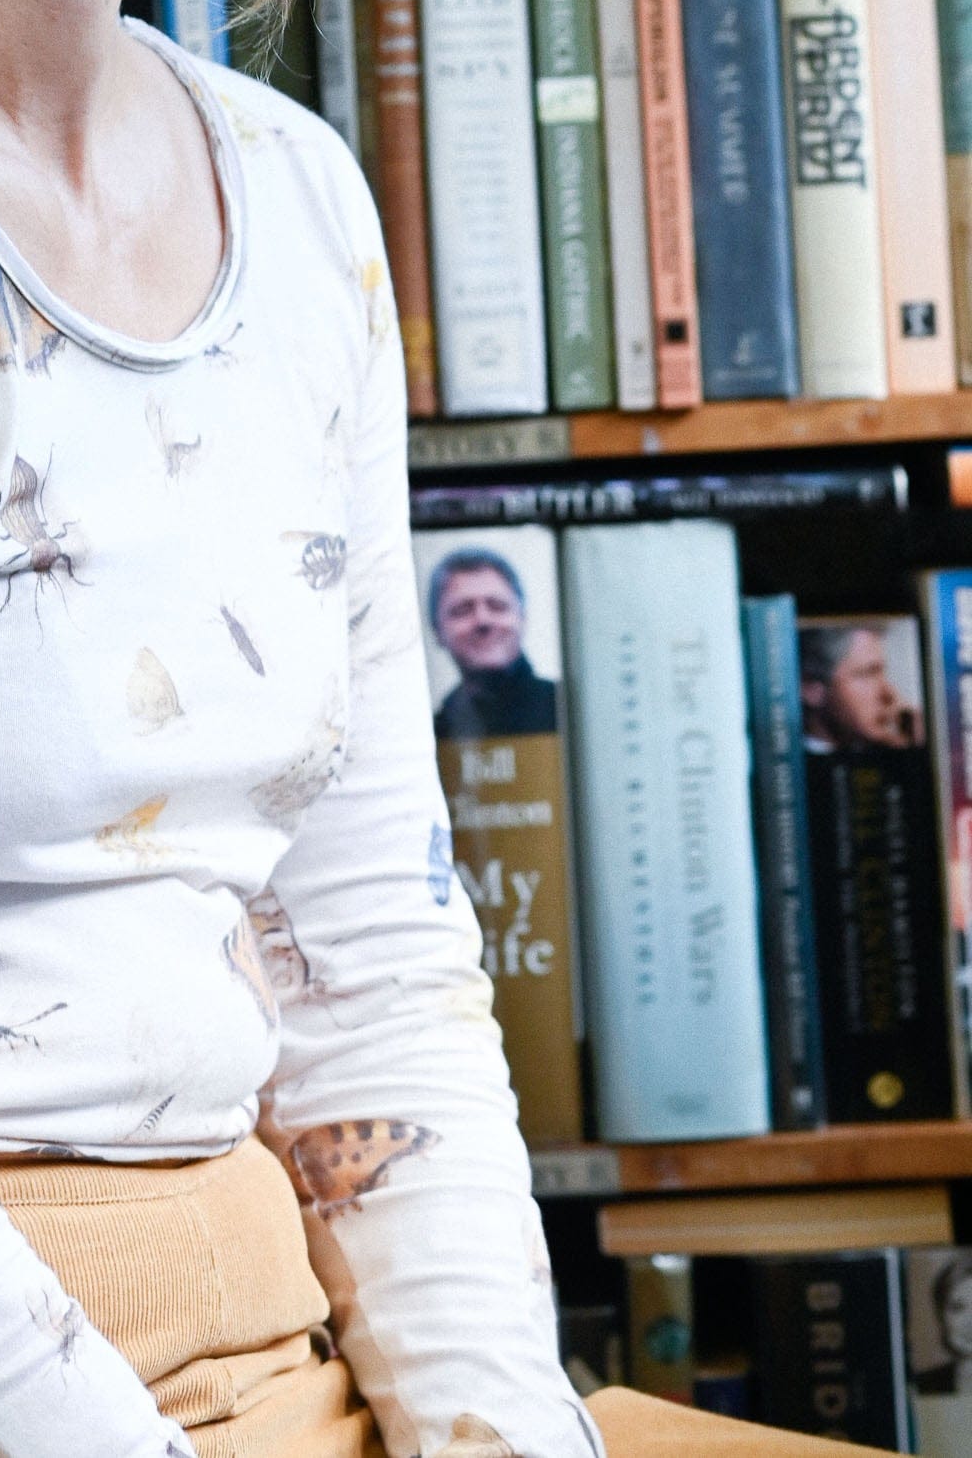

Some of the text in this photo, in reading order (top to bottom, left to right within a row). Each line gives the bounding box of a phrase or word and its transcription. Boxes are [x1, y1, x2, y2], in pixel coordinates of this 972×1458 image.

[714, 66, 752, 204] SUMMER
[834, 8, 868, 194] ARDENT
[555, 125, 596, 342] INDIANA GOTHIC
[459, 746, 516, 785] Bill
[668, 633, 727, 1009] The Clinton Wars
[455, 859, 541, 933] My
[482, 921, 555, 978] ife
